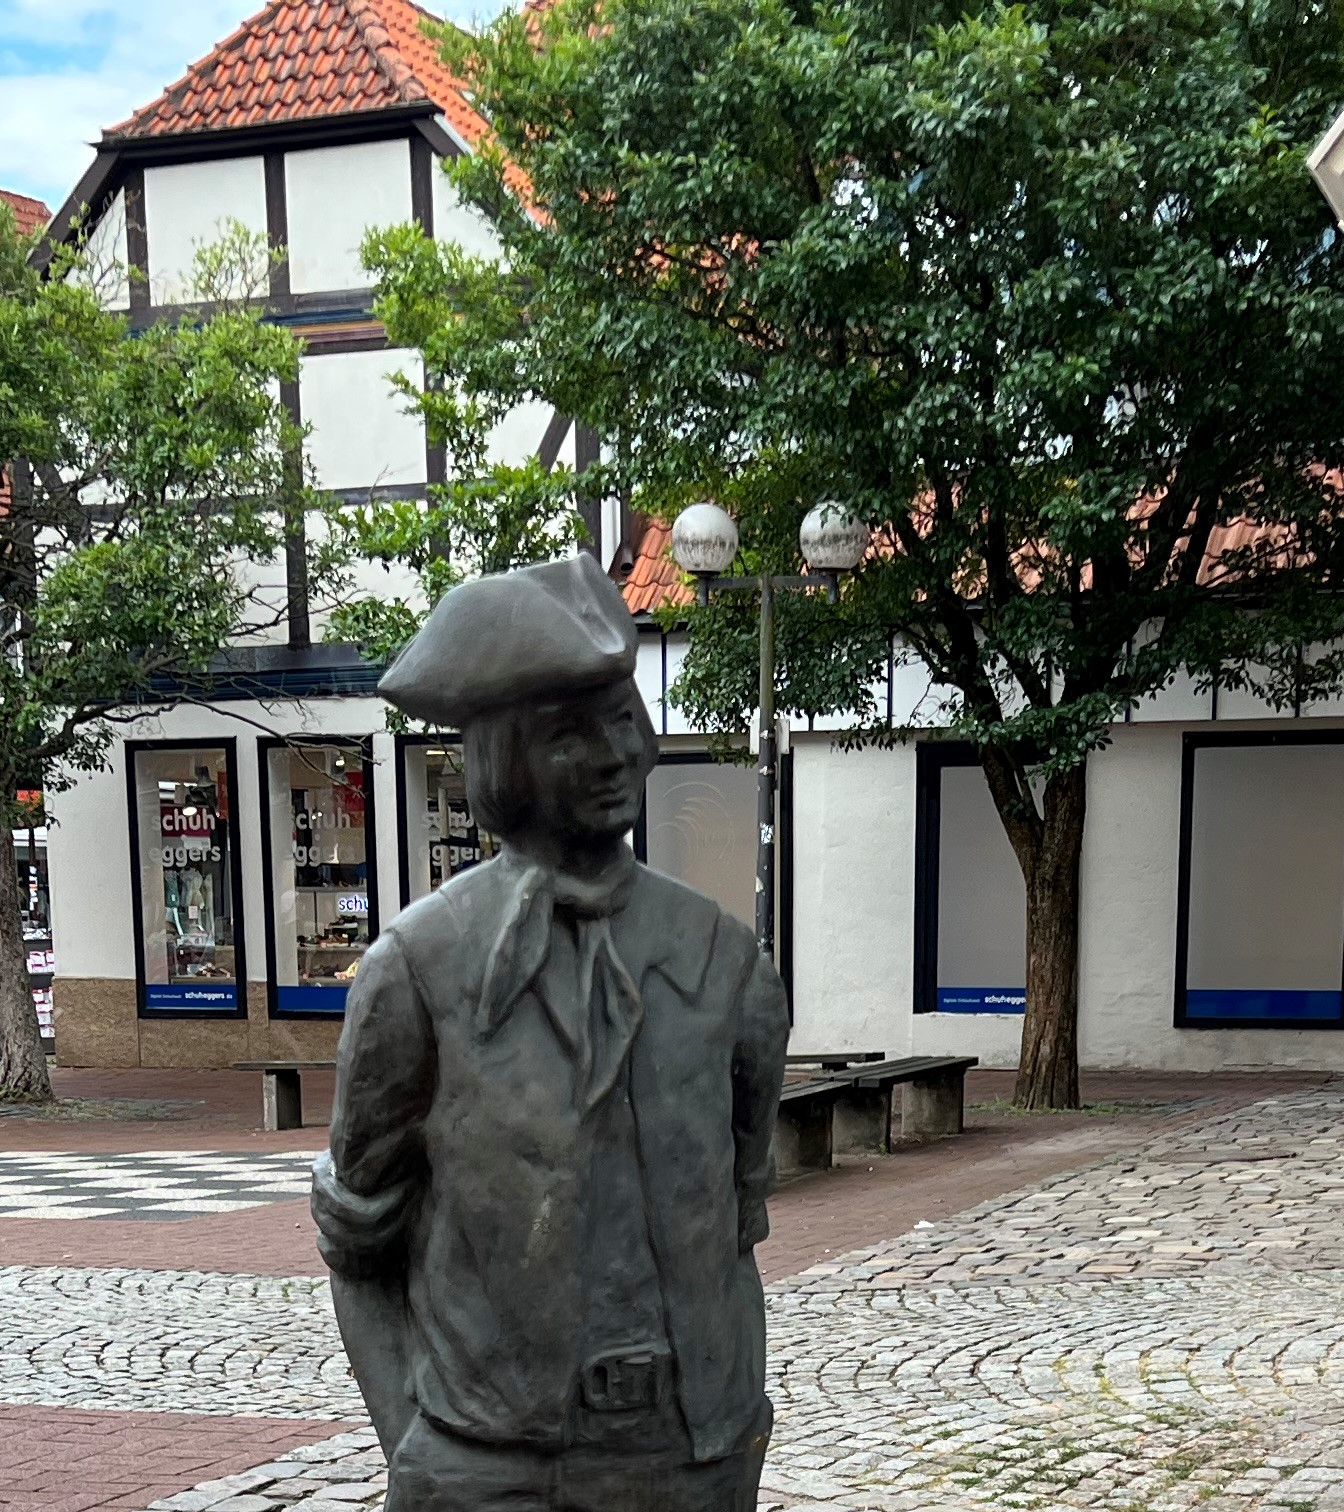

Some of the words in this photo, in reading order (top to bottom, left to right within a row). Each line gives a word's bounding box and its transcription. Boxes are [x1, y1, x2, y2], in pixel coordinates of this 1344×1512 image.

[152, 808, 216, 831] schuh
[292, 806, 351, 830] chuh
[150, 846, 222, 867] eggers
[423, 844, 481, 867] gger
